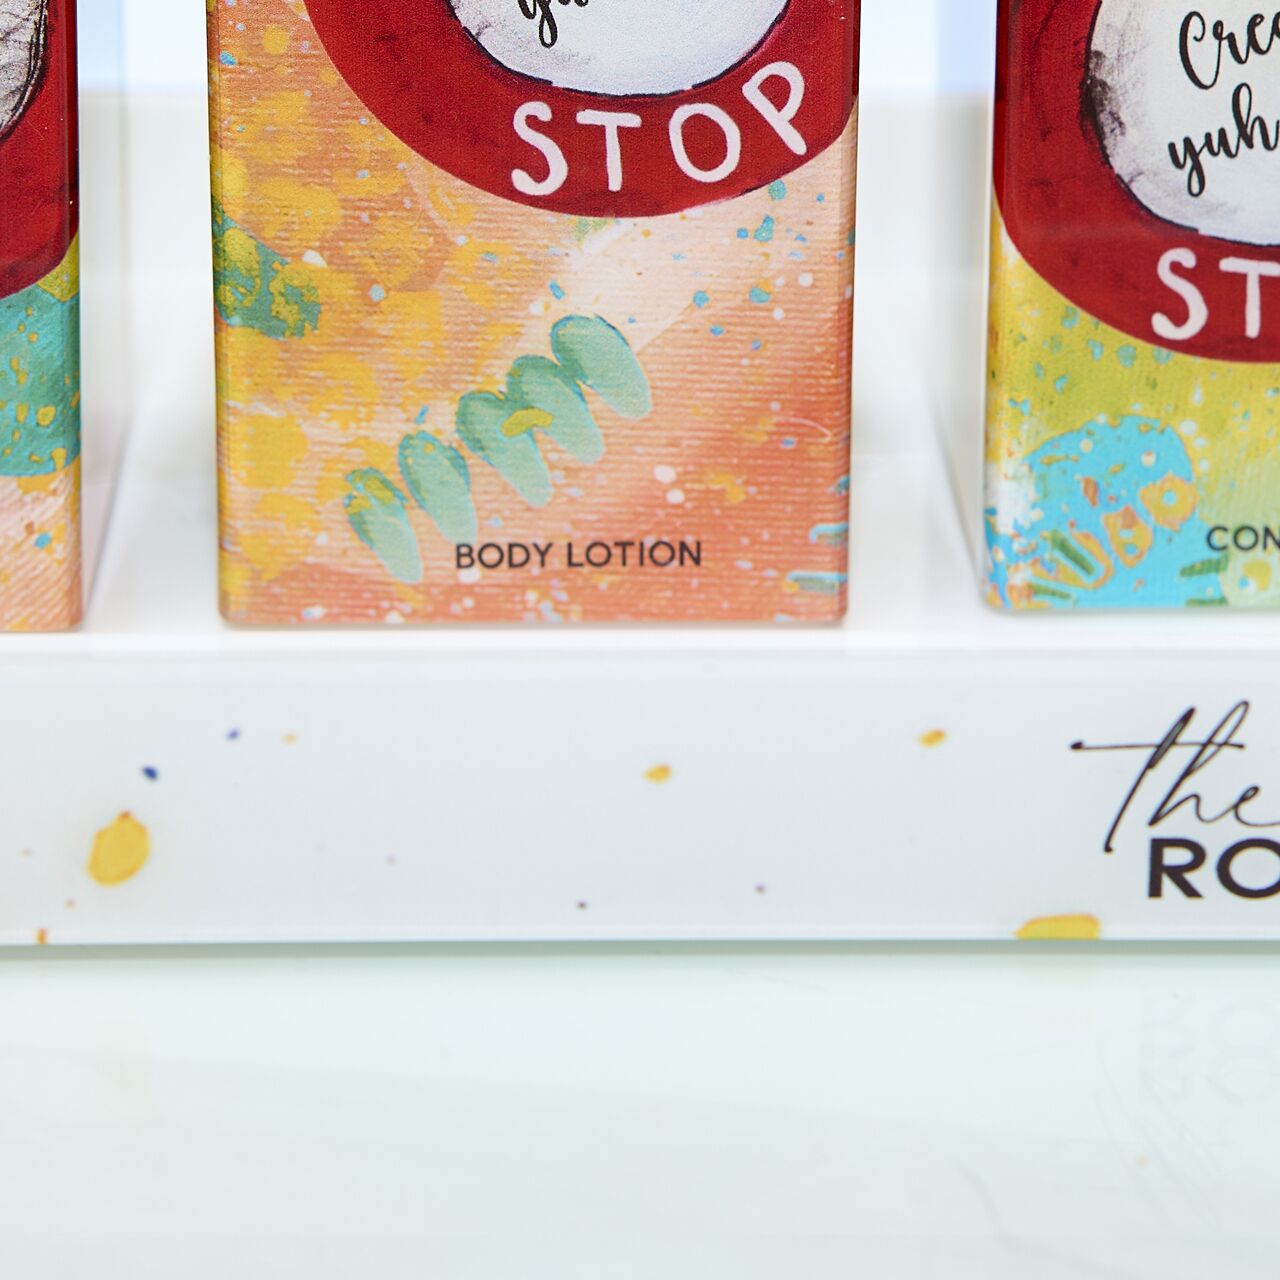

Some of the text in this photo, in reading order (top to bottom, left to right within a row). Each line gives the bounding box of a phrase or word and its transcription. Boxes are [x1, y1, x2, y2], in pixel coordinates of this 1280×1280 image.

[512, 61, 806, 196] STOP
[1167, 83, 1280, 198] yuh
[455, 541, 702, 569] BODY LOTION
